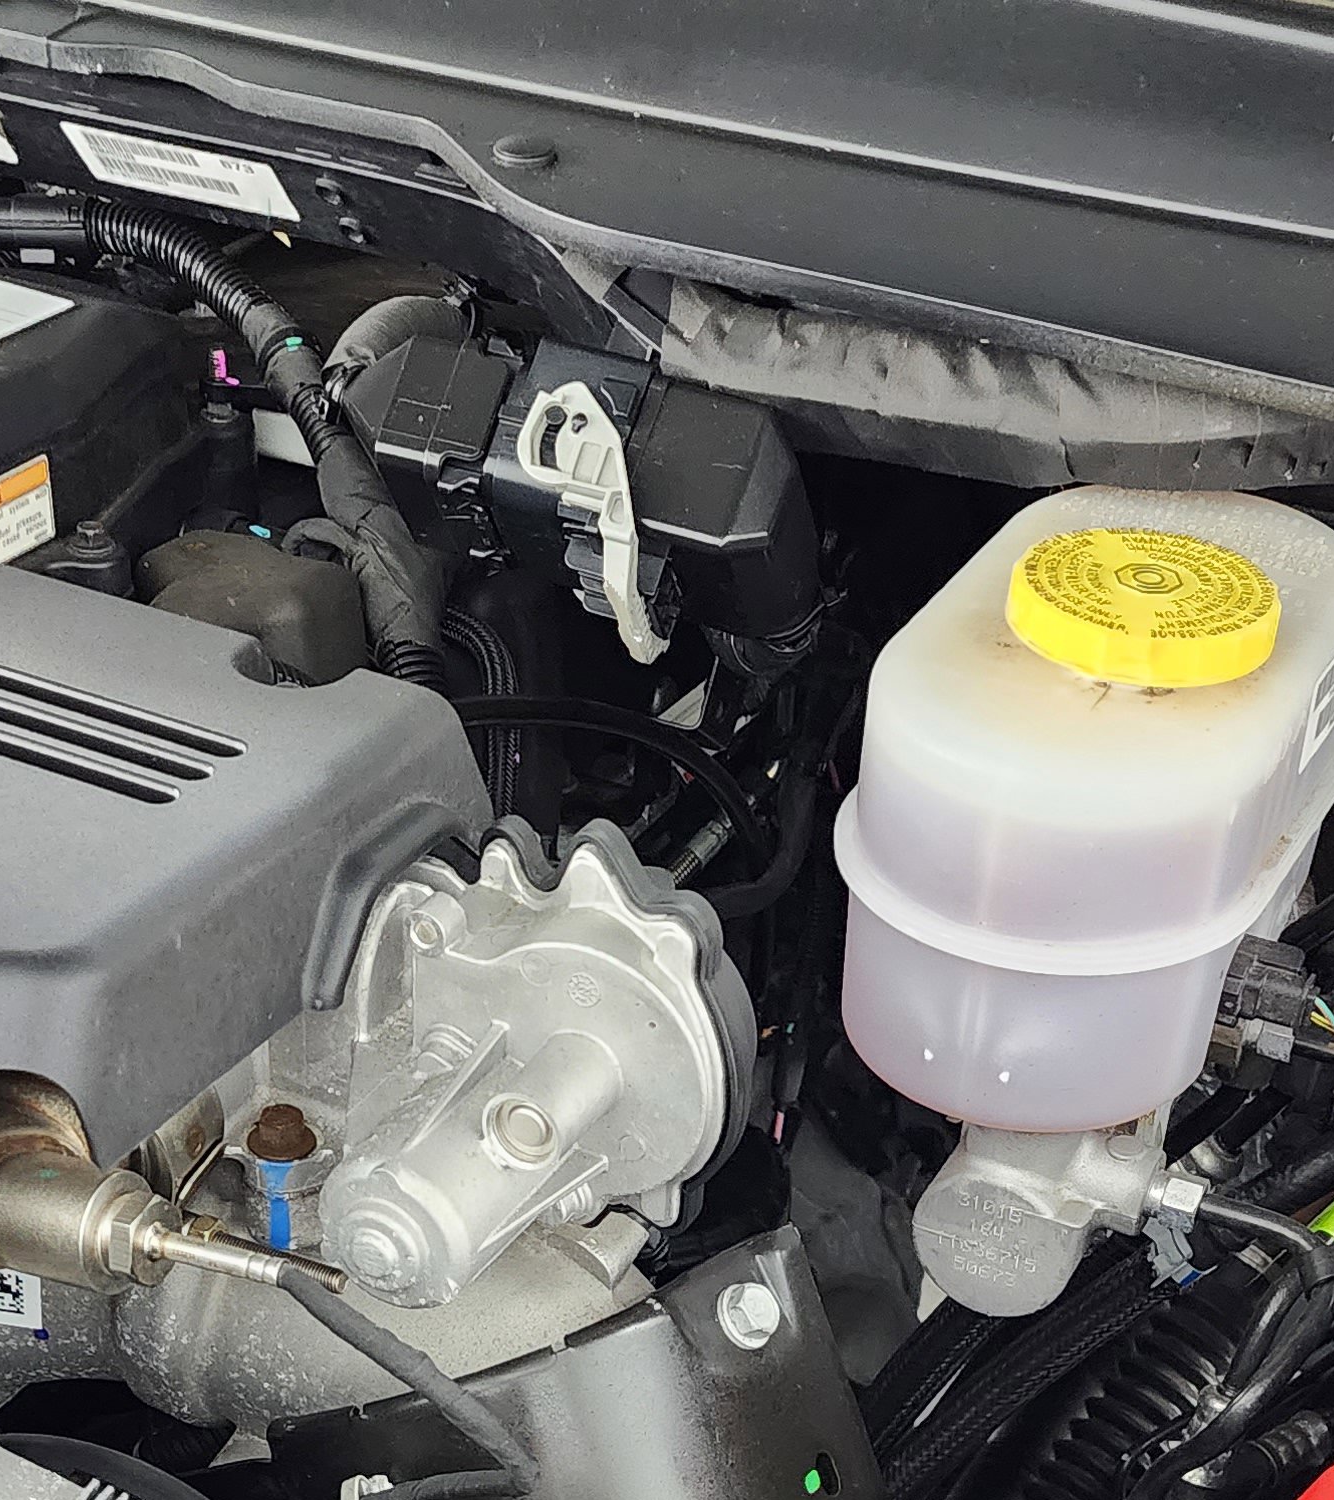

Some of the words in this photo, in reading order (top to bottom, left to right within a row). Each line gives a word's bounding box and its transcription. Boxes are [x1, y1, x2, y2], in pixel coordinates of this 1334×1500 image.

[1120, 535, 1167, 547] AVANT
[1083, 591, 1113, 606] CAP
[1054, 601, 1130, 635] CONTAINER.
[1086, 605, 1123, 621] ONLY
[1154, 609, 1189, 620] D'UN
